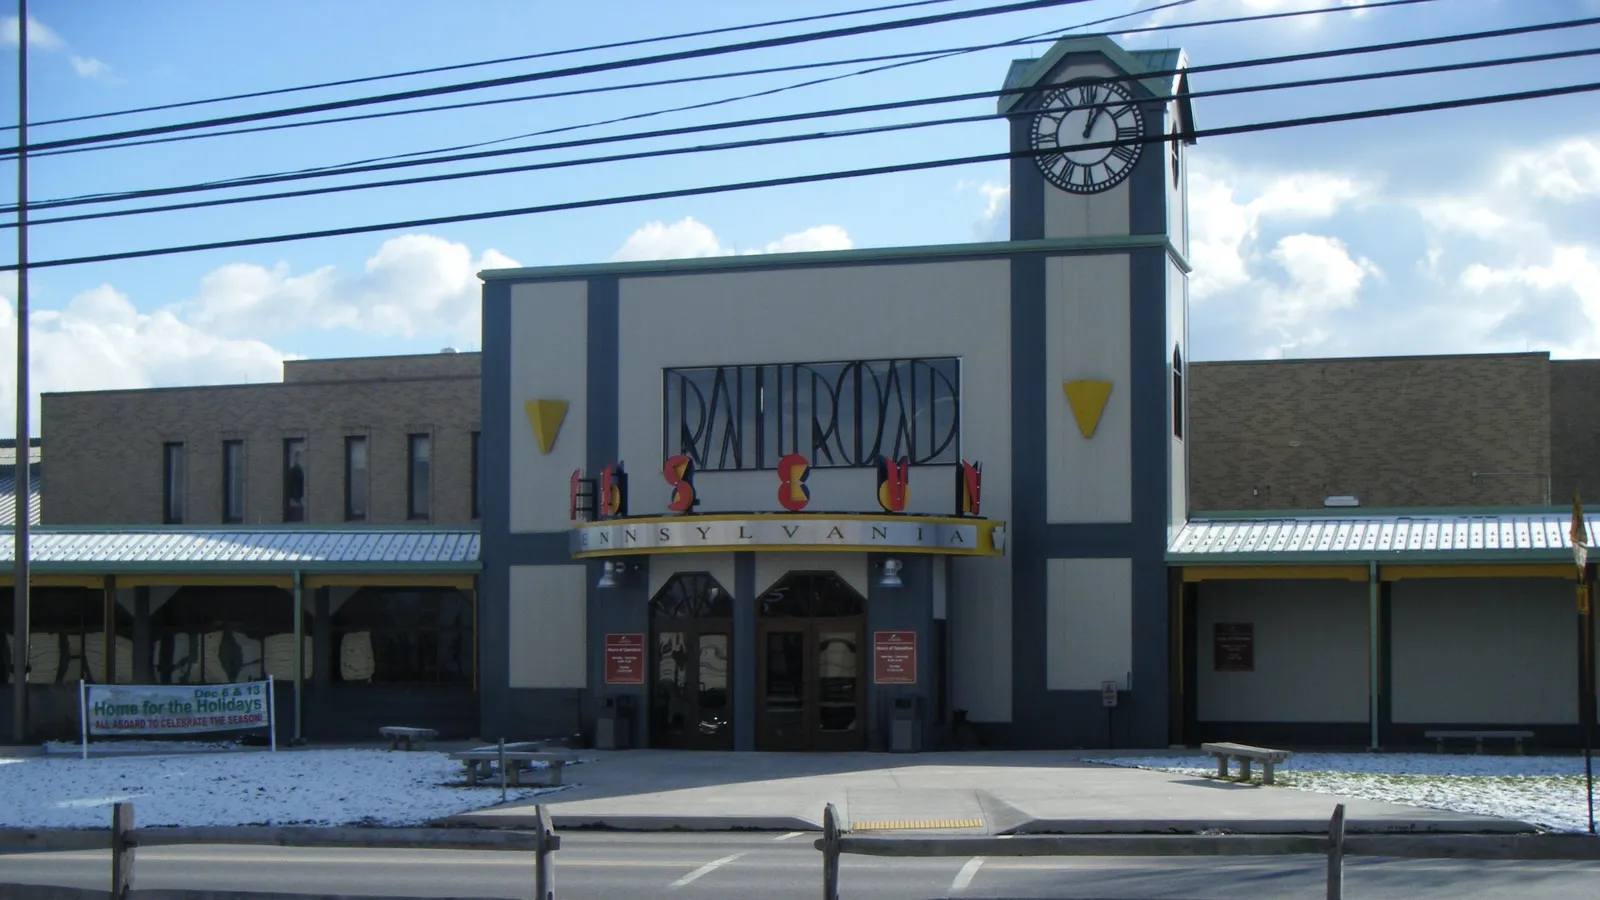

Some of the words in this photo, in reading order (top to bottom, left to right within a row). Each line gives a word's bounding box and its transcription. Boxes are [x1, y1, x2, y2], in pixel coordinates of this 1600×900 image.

[664, 357, 959, 470] RAILROAD
[582, 525, 964, 546] ENNSYLVANIA
[195, 689, 218, 698] Dec
[221, 688, 229, 697] 6
[232, 687, 242, 696] &
[246, 685, 261, 695] 13
[94, 701, 138, 715] Home
[143, 700, 165, 715] for
[168, 699, 192, 714] the
[196, 697, 262, 713] Holidays
[95, 720, 110, 729] ALL
[113, 719, 146, 729] ABOARD
[148, 719, 159, 728] TO
[161, 717, 208, 728] CELEBRATE
[209, 715, 227, 725] THE
